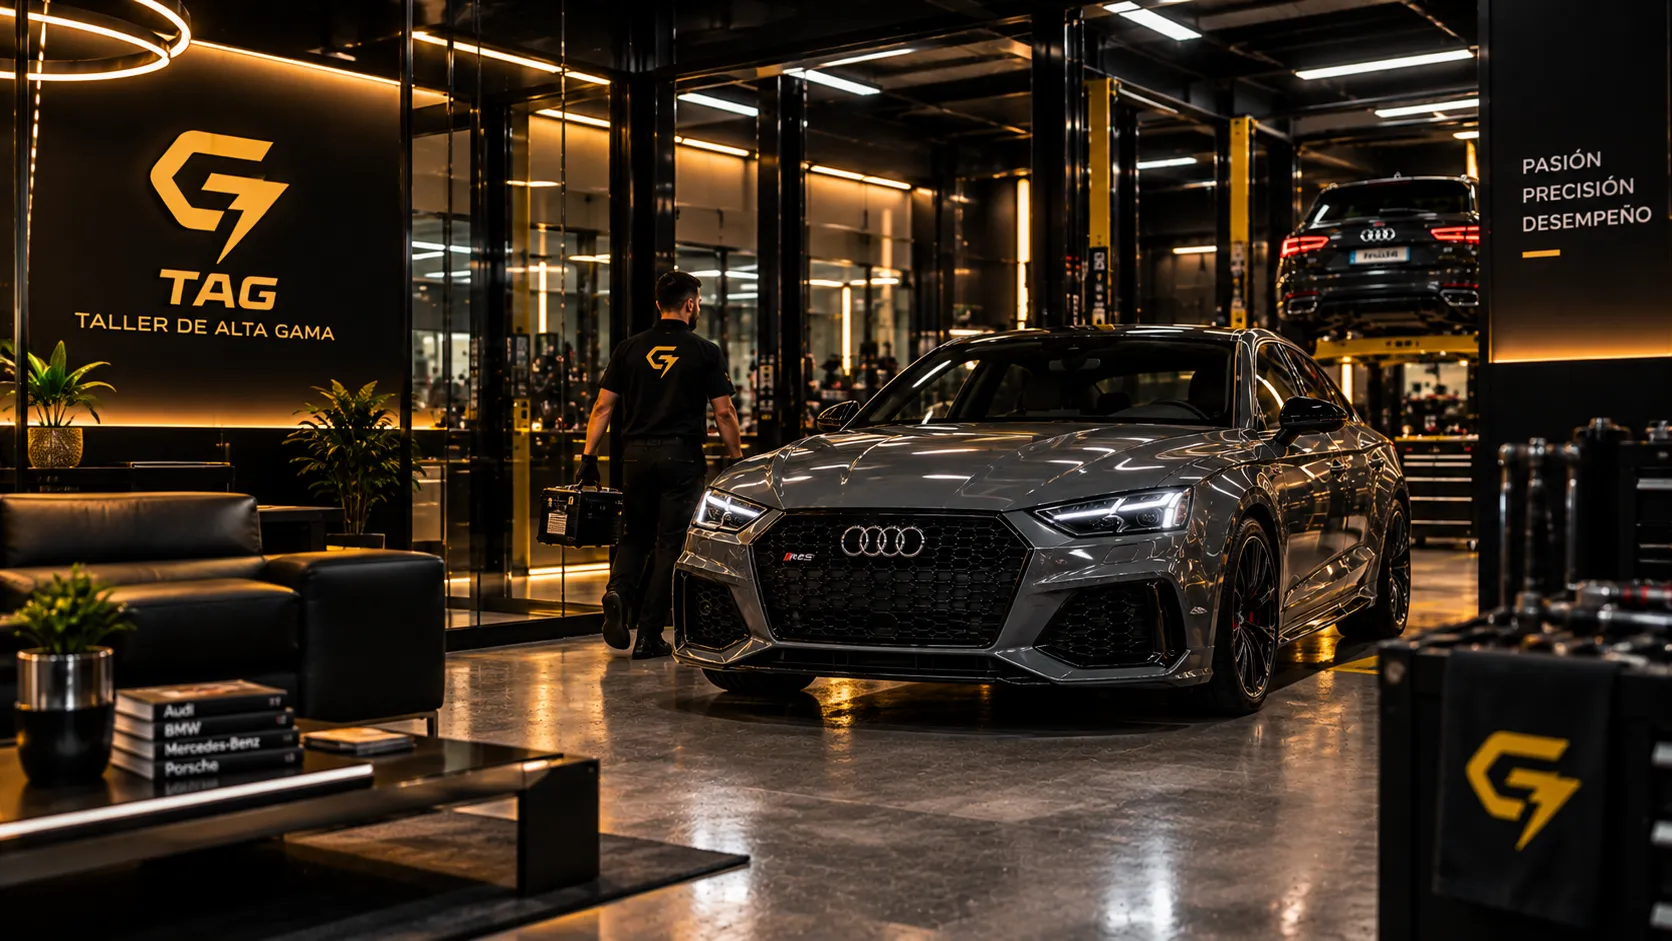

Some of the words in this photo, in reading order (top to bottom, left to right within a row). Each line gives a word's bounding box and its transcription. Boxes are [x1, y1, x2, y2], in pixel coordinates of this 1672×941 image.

[1522, 148, 1602, 175] PASIÓN
[1522, 175, 1635, 204] PRECISIÓN
[1522, 204, 1653, 233] DESEMPEÑO
[159, 268, 279, 311] TAG
[74, 312, 169, 334] TALLER
[177, 318, 208, 336] DE
[214, 320, 268, 339] ALTA
[274, 323, 335, 342] GAMA
[163, 703, 195, 718] Audi
[164, 721, 201, 737] BMW
[164, 737, 260, 756] Mercedes-Benz
[164, 759, 219, 776] Porsche
